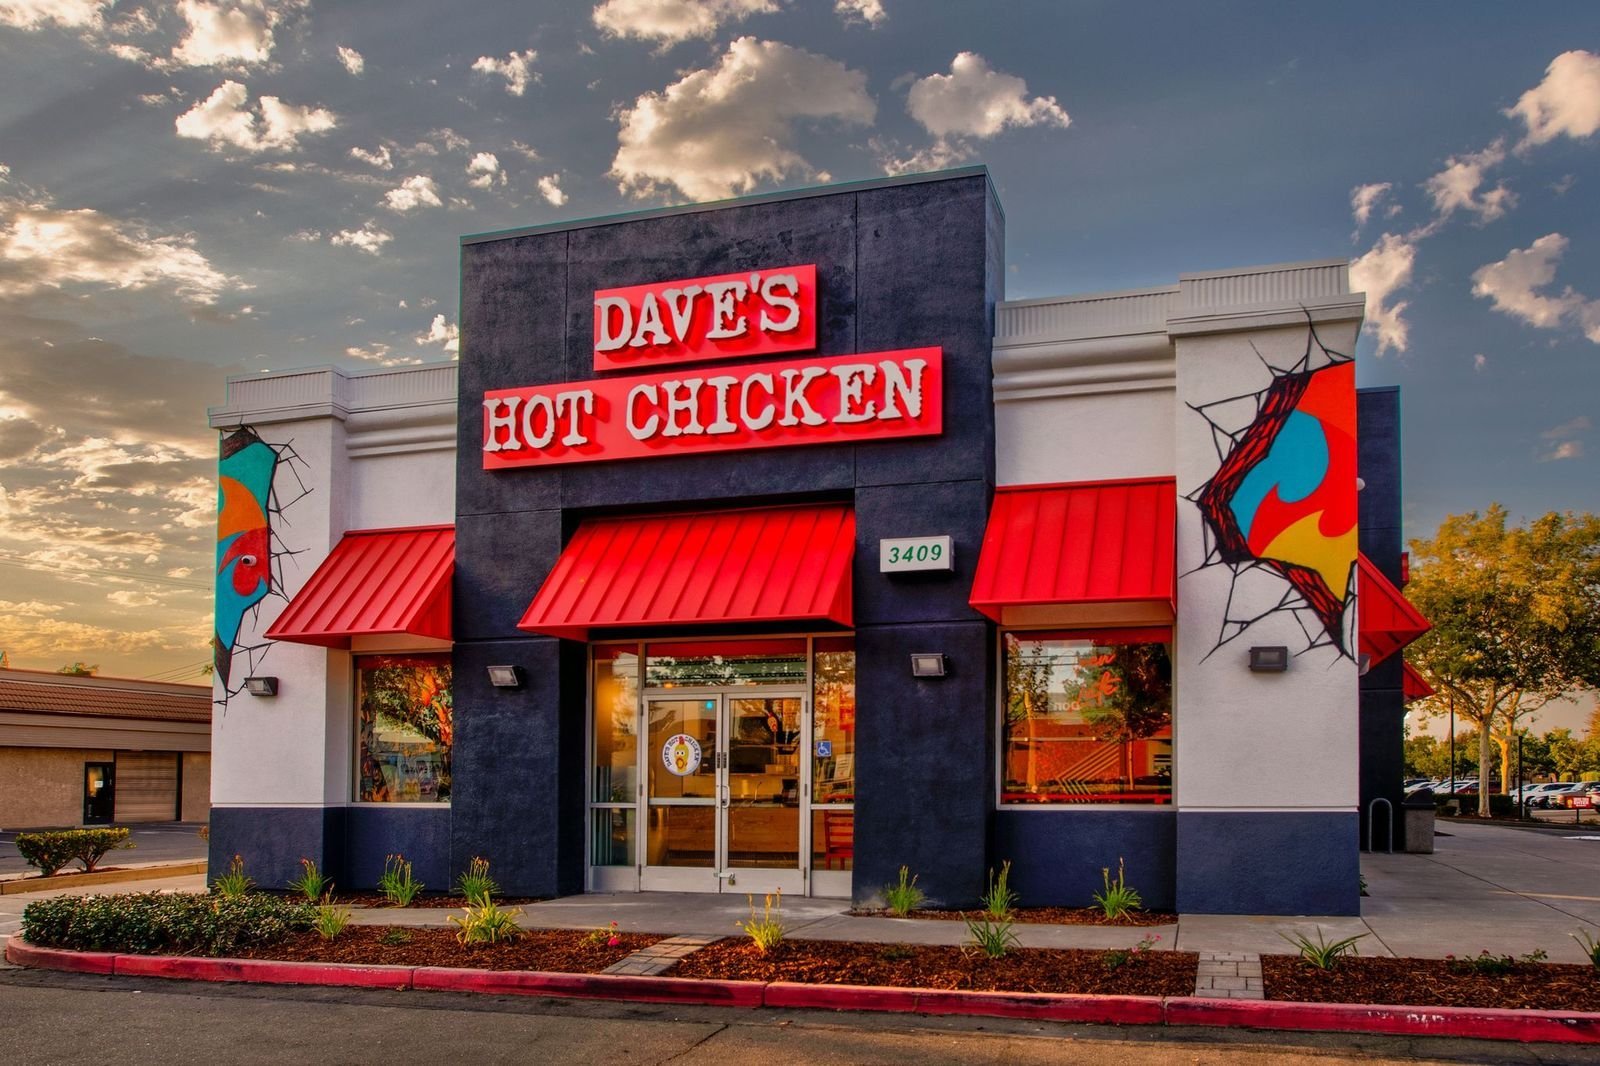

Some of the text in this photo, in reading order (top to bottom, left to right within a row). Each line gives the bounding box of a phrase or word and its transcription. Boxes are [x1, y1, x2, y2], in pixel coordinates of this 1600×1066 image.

[595, 273, 799, 351] DAVE'S
[482, 358, 927, 452] HOT CHICKEN
[888, 544, 942, 564] 3409
